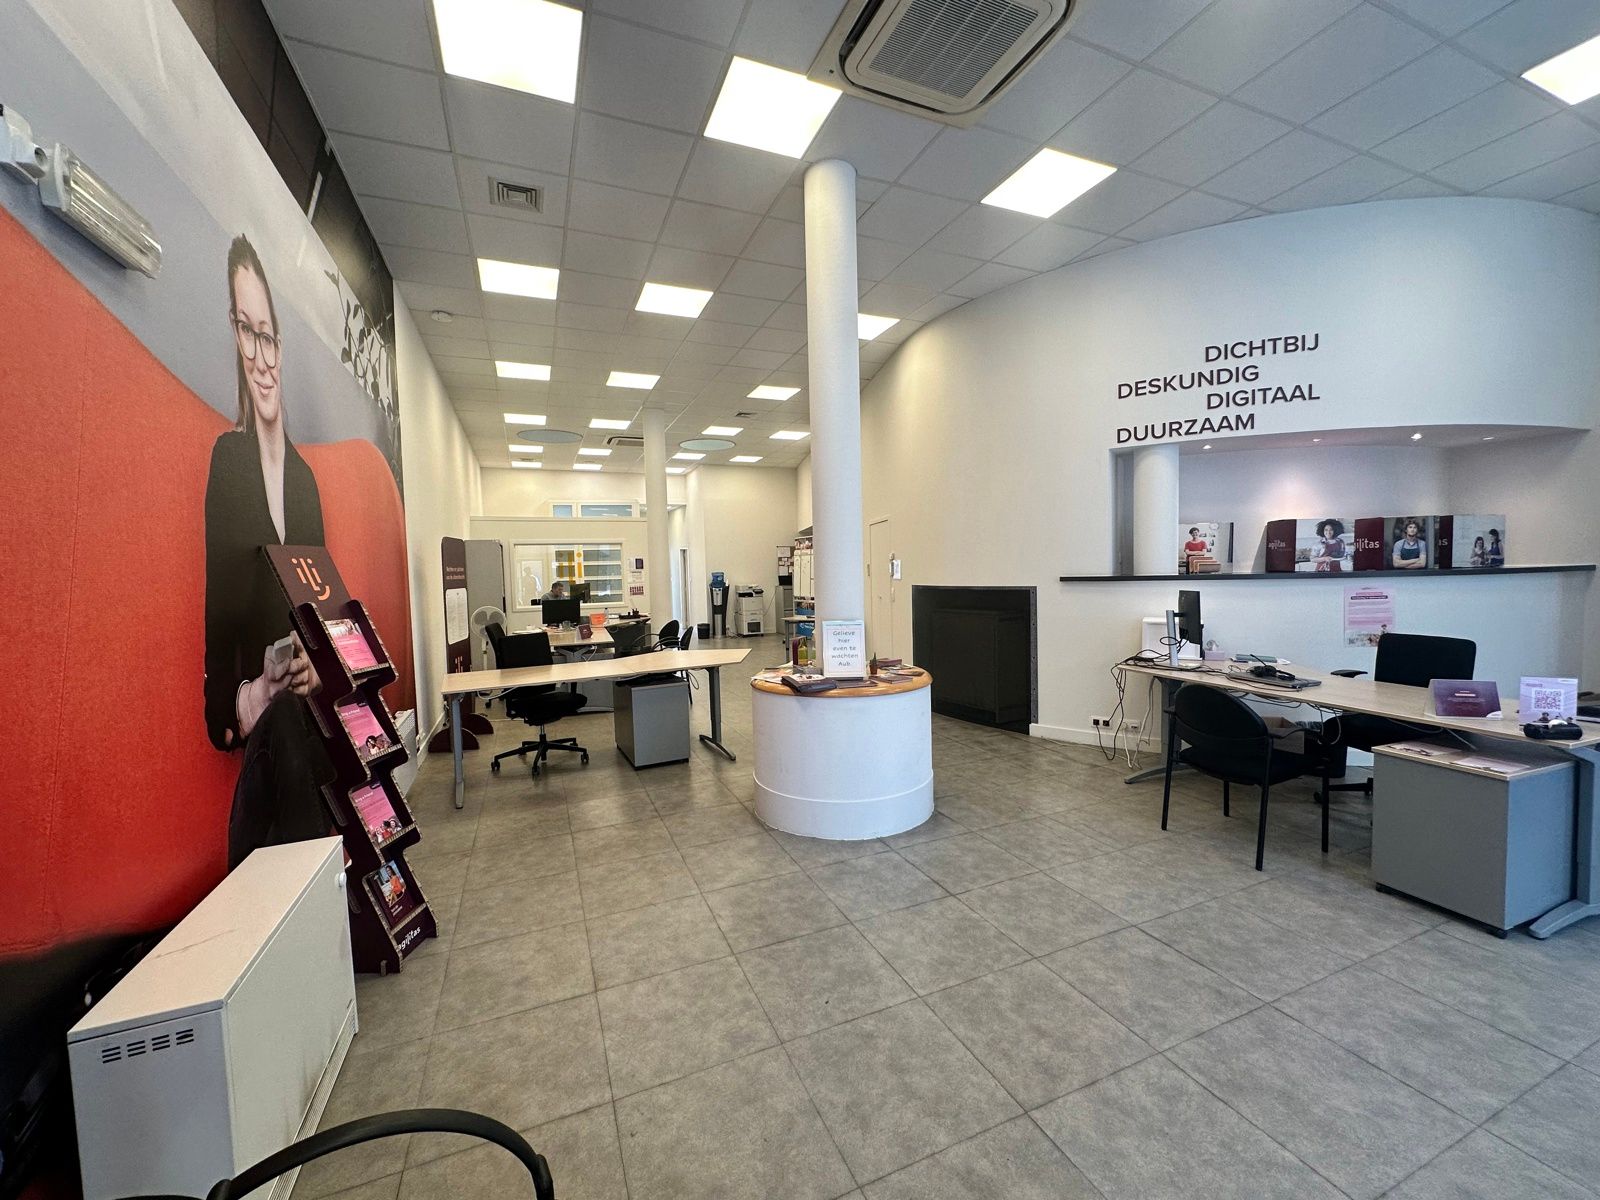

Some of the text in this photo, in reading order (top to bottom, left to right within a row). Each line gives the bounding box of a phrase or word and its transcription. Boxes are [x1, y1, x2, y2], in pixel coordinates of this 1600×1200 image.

[1205, 333, 1319, 362] DICHTBIJ
[1117, 365, 1260, 399] DESKUNDIG
[1206, 383, 1320, 409] DIGITAAL
[1116, 413, 1255, 443] DUURZAAM
